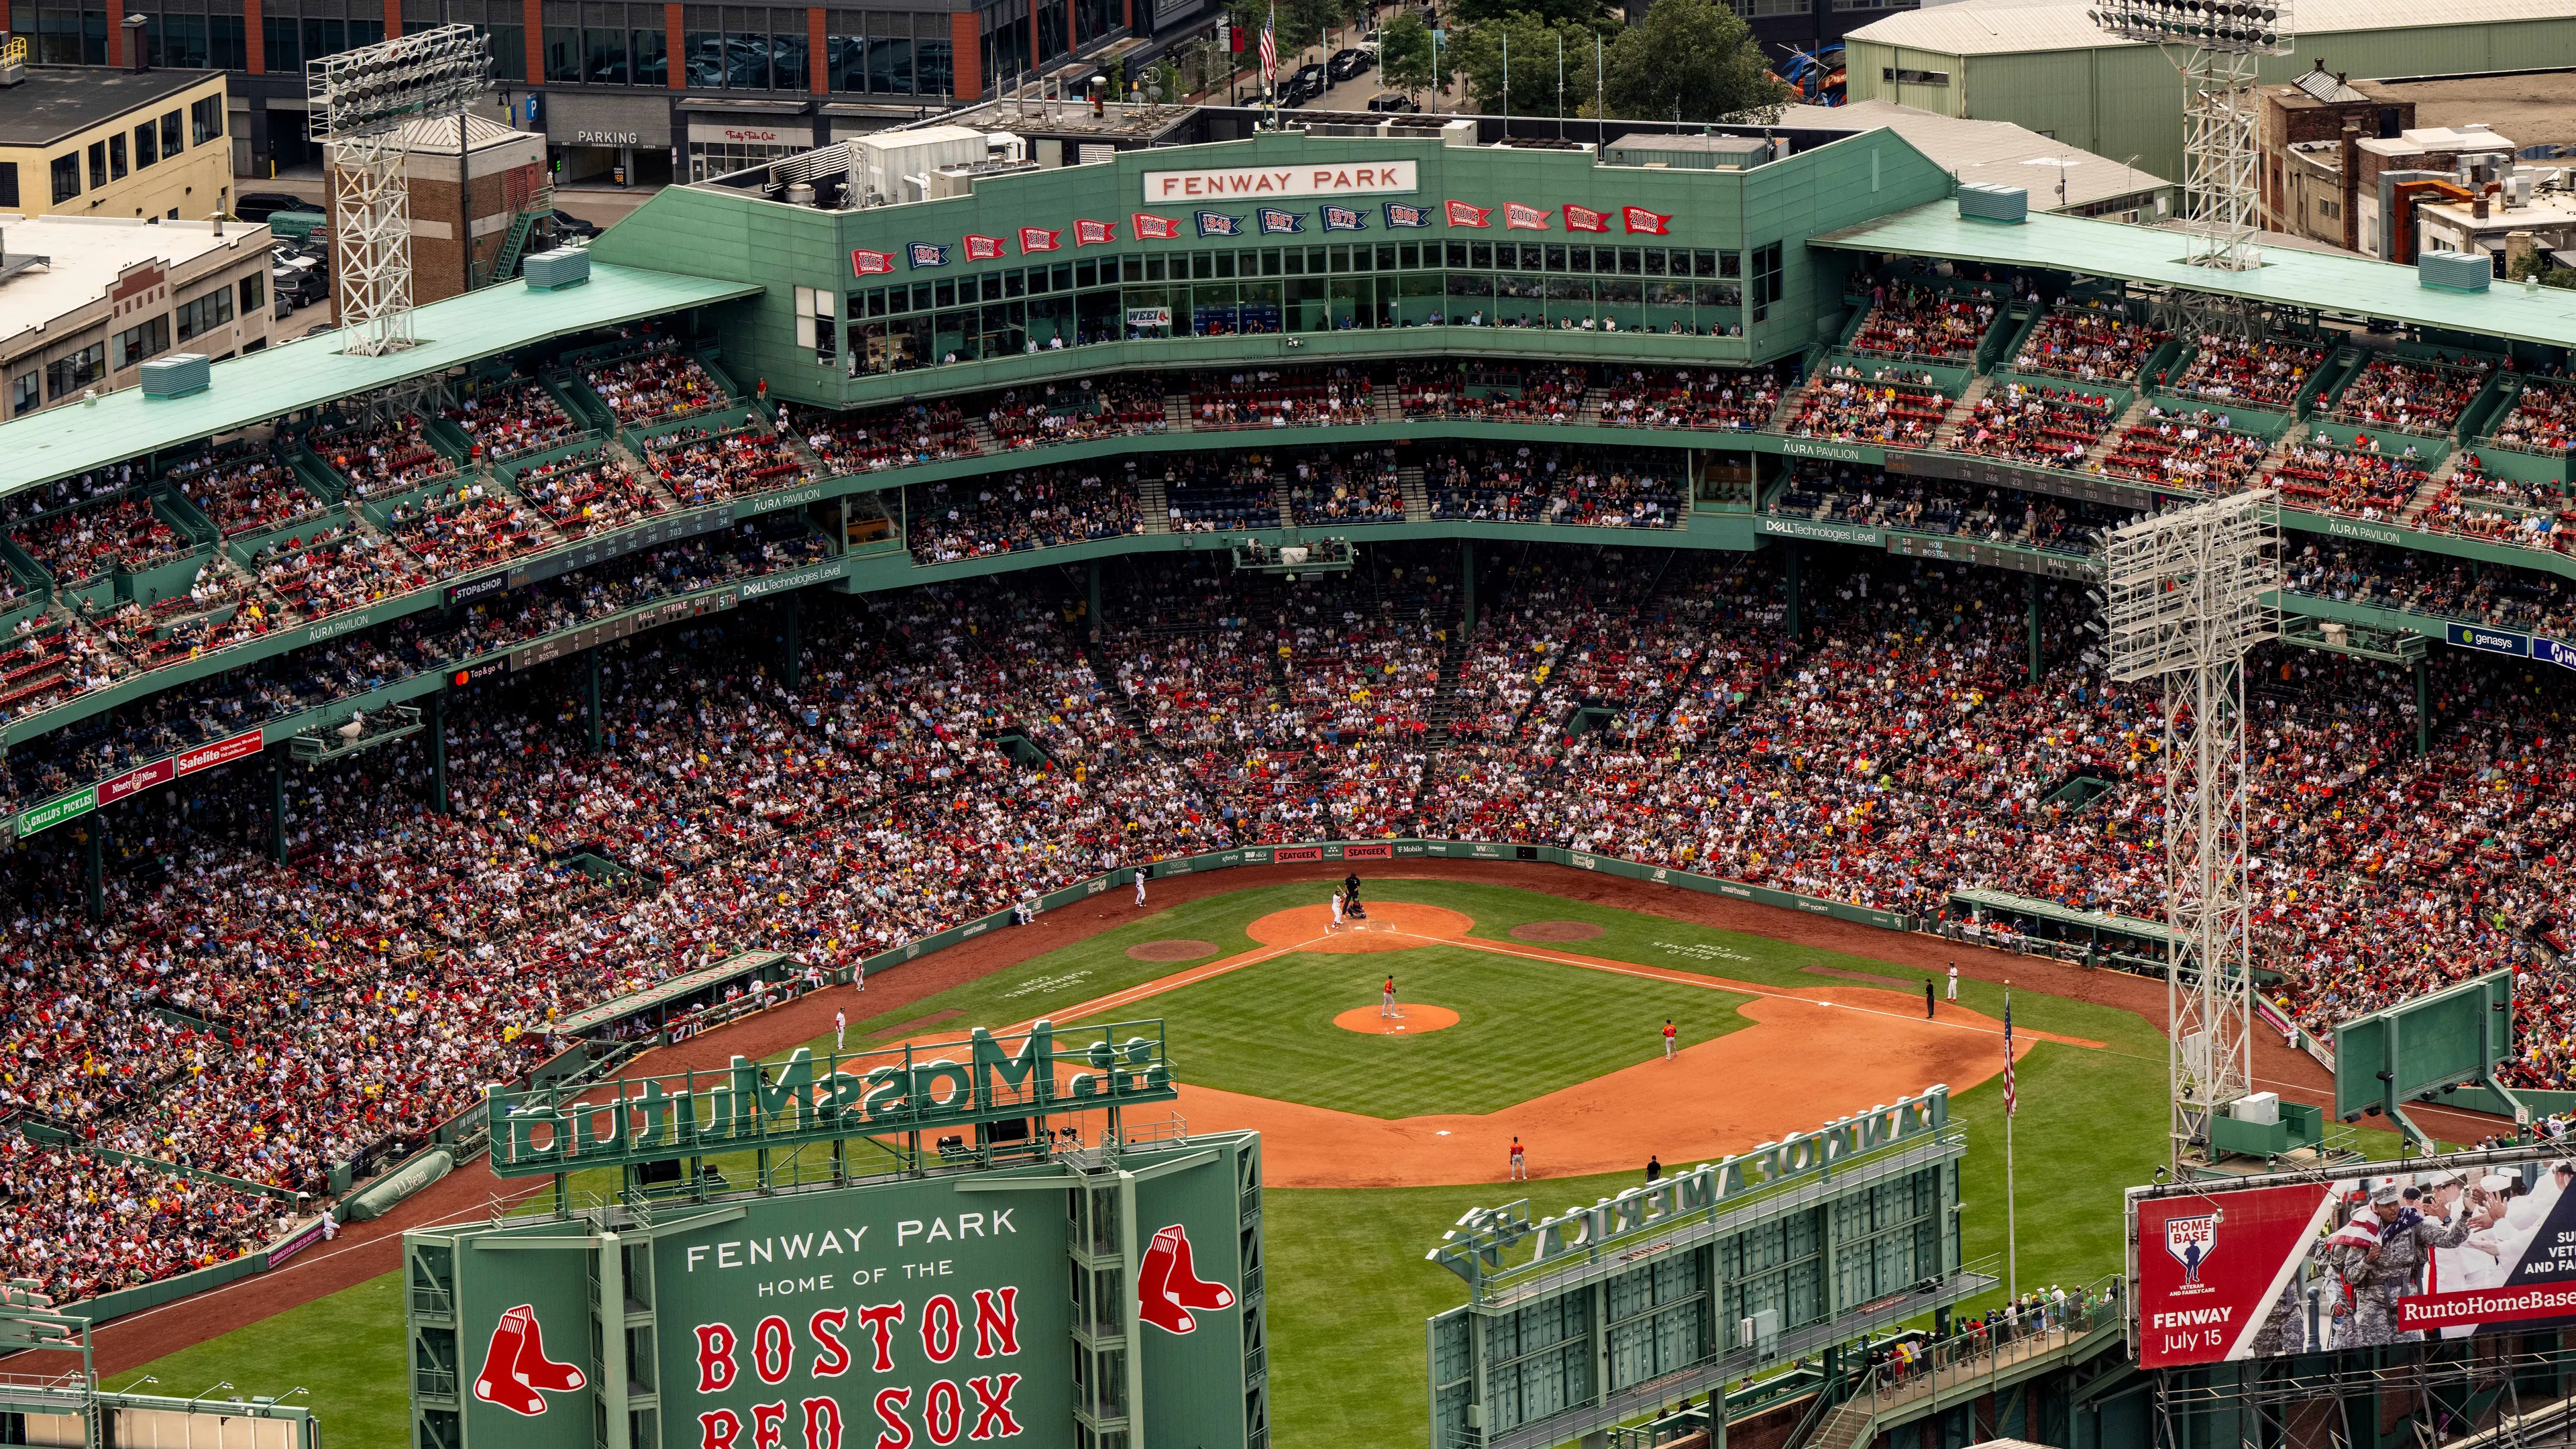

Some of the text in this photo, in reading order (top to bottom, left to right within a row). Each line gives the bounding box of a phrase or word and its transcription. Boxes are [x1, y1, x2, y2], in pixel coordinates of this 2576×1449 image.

[531, 100, 537, 117] P
[578, 131, 637, 144] PARKING
[725, 130, 776, 142] Tasty Take Out
[1163, 168, 1397, 195] FENWAY PARK
[1328, 211, 1356, 225] 1975
[1391, 209, 1419, 222] 1986
[1451, 207, 1480, 222] 2004
[1454, 217, 1478, 225] CHAMPIONS
[1509, 209, 1539, 223] 2007
[1570, 211, 1599, 226] 2013
[1629, 213, 1658, 228] 2018
[1141, 219, 1167, 232] 1918
[1202, 217, 1231, 229] 1946
[1265, 215, 1294, 228] 1967
[1513, 220, 1538, 228] CHAMPIONS
[1572, 223, 1597, 231] CHAMPIONS
[1082, 225, 1105, 237] 1916
[1632, 225, 1657, 233] CHAMPIONS
[1026, 233, 1049, 245] 1915
[971, 241, 994, 252] 1912
[914, 249, 939, 260] 1904
[859, 256, 884, 268] 1903
[1128, 310, 1159, 321] WEEI
[1817, 447, 1859, 460] PAVILION
[1986, 473, 1998, 482] 266
[783, 488, 820, 505] PAVILION
[2083, 490, 2098, 499] .703
[2135, 498, 2144, 506] 34
[718, 517, 728, 525] 34
[669, 528, 682, 537] .703
[1766, 520, 1876, 543] DELL Technologies Level
[2360, 527, 2400, 543] PAVILION
[646, 534, 657, 543] .391
[1929, 541, 1943, 549] HOU
[625, 541, 637, 550] .312
[586, 553, 596, 563] 266
[1923, 549, 1949, 559] BOSTON
[567, 559, 574, 568] 78
[2047, 558, 2068, 569] BALL
[511, 573, 530, 586] SMITH
[743, 564, 841, 596] DELL Technologies Level
[638, 593, 737, 621] BALL STRIKE OUT 5TH
[335, 614, 368, 633] PAVILION
[523, 649, 531, 657] 58
[543, 642, 554, 651] HOU
[574, 633, 579, 641] 6
[2475, 634, 2512, 649] genasys
[524, 658, 531, 666] 40
[539, 649, 559, 661] BOSTON
[179, 749, 220, 771] Safelite
[112, 770, 157, 794] Ninety Nine
[31, 794, 93, 826] GRILLO'S PICKLES
[1222, 854, 1239, 863] xfinity
[1279, 850, 1317, 861] SEATGEEK
[1348, 847, 1387, 857] SEATGEEK
[1572, 853, 1586, 862] Ninety
[1088, 885, 1099, 894] Nine
[1721, 885, 1750, 897] smartwater
[963, 922, 987, 937] smartwater
[1651, 942, 1752, 961] SUBMARINES
[1667, 950, 1713, 960] BUILD
[676, 955, 771, 986] BOSTON
[1004, 970, 1093, 998] SUBMARINES
[1042, 979, 1085, 994] BUILD
[623, 988, 678, 1004] RED
[574, 1005, 629, 1022] SOX
[467, 1111, 478, 1124] BEAM
[2169, 1219, 2212, 1233] HOME
[687, 1208, 1017, 1273] FENWAY PARK
[2174, 1231, 2208, 1244] BASE
[2557, 1232, 2576, 1243] SU
[272, 1228, 323, 1262] AMERICA'S NETWORK
[2524, 1260, 2576, 1275] AND FA
[759, 1260, 954, 1297] HOME OF THE
[2153, 1307, 2233, 1329] FENWAY
[693, 1286, 1022, 1395] BOSTON
[2161, 1329, 2222, 1354] July 15
[696, 1373, 1024, 1449] RED SOX
